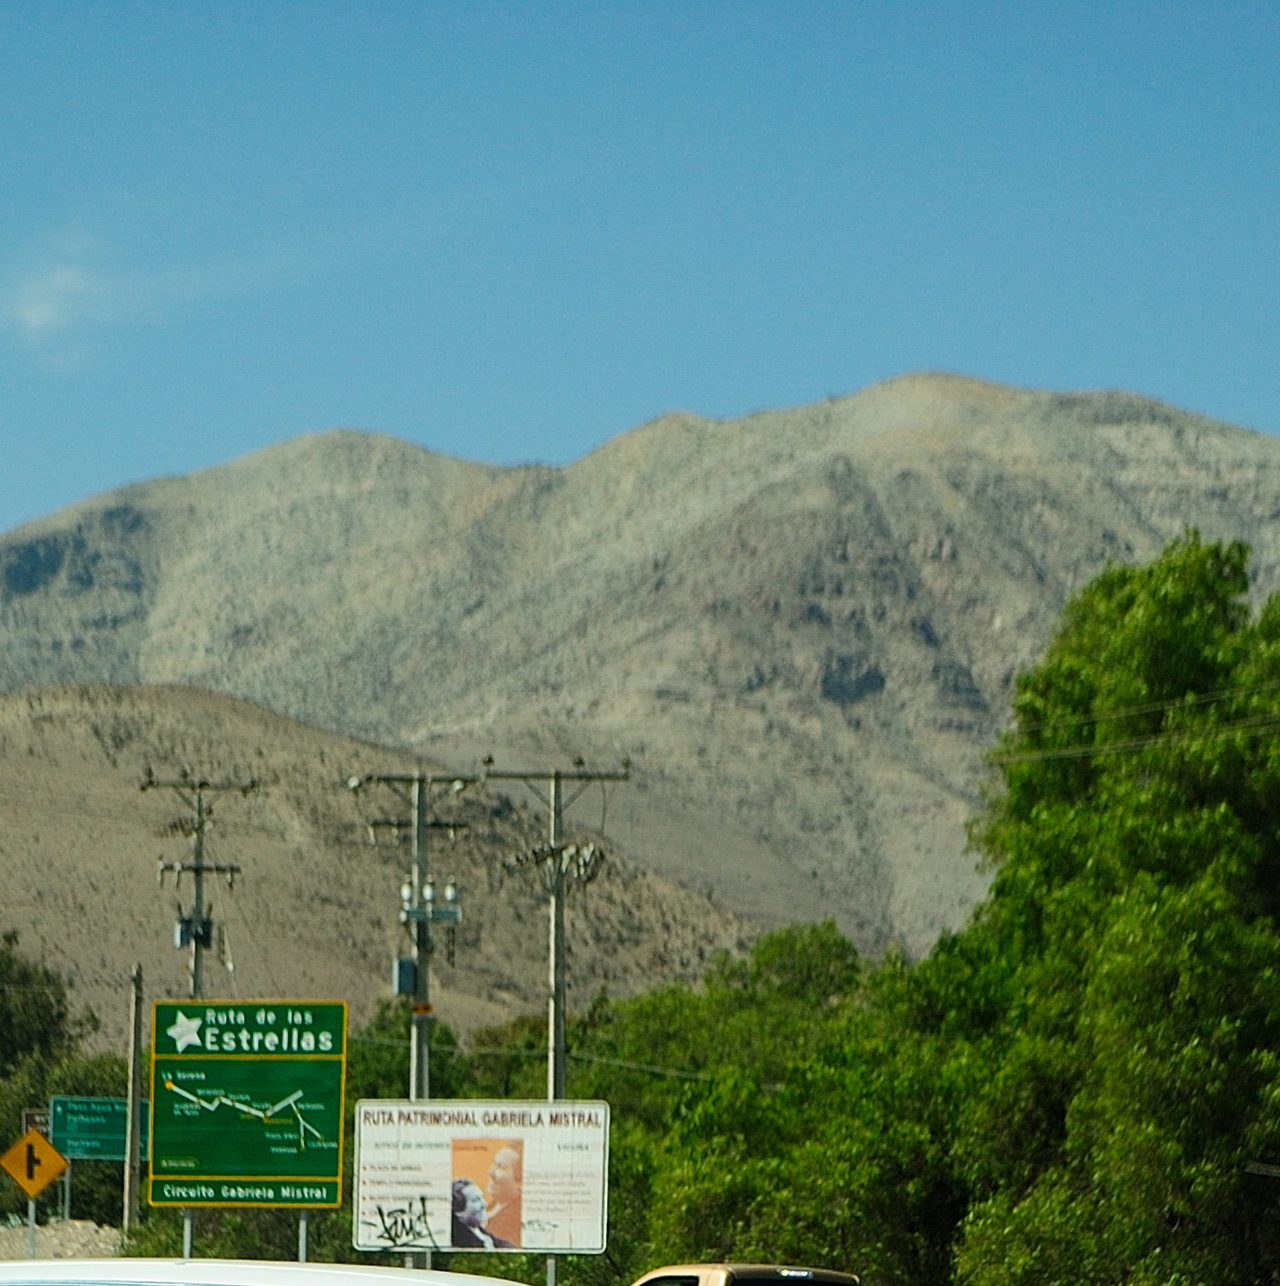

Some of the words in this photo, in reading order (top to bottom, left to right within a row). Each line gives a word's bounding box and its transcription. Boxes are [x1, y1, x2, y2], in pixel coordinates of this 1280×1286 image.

[205, 1008, 245, 1025] Ruta
[256, 1009, 277, 1025] de
[287, 1009, 313, 1025] las
[205, 1027, 333, 1051] Estrellas
[363, 1111, 394, 1126] RUTA
[398, 1111, 477, 1127] PATRIMONIAL
[483, 1112, 544, 1127] GABRIELA
[549, 1112, 601, 1128] MISTRAL
[163, 1184, 215, 1198] Circuito
[221, 1185, 275, 1199] Gabriela
[281, 1186, 327, 1199] Mistral
